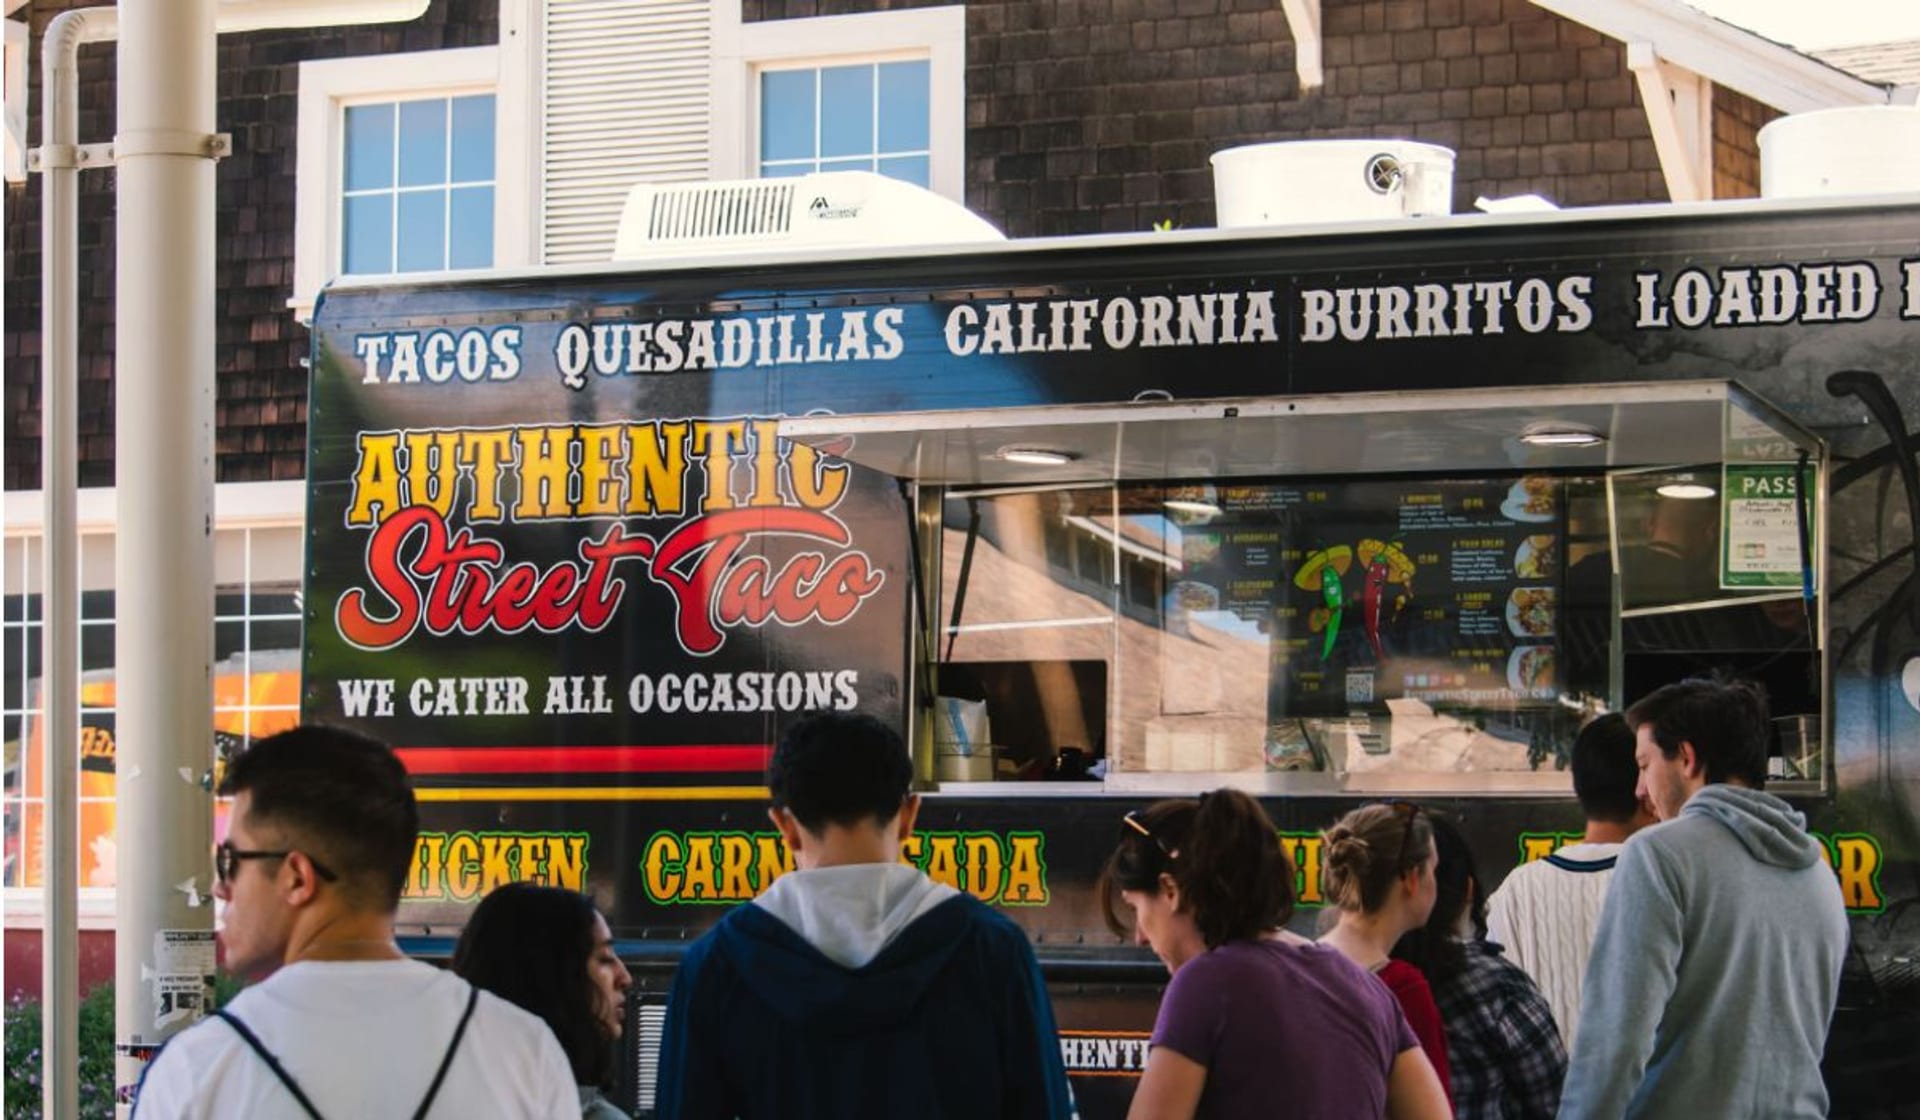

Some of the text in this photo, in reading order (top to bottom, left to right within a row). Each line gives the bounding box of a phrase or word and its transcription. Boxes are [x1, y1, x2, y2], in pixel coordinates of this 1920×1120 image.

[356, 327, 521, 384] TACOS
[555, 308, 905, 390] QUESADILLAS
[945, 291, 1279, 357] CALIFORNIA
[1301, 276, 1593, 342] BURRITOS
[1635, 263, 1878, 328] LOADED
[346, 418, 849, 525] AUTHENTIC
[1742, 476, 1797, 494] PASS
[337, 506, 884, 655] Street Taco
[338, 671, 860, 717] WE CATER ALL OCCASIONS
